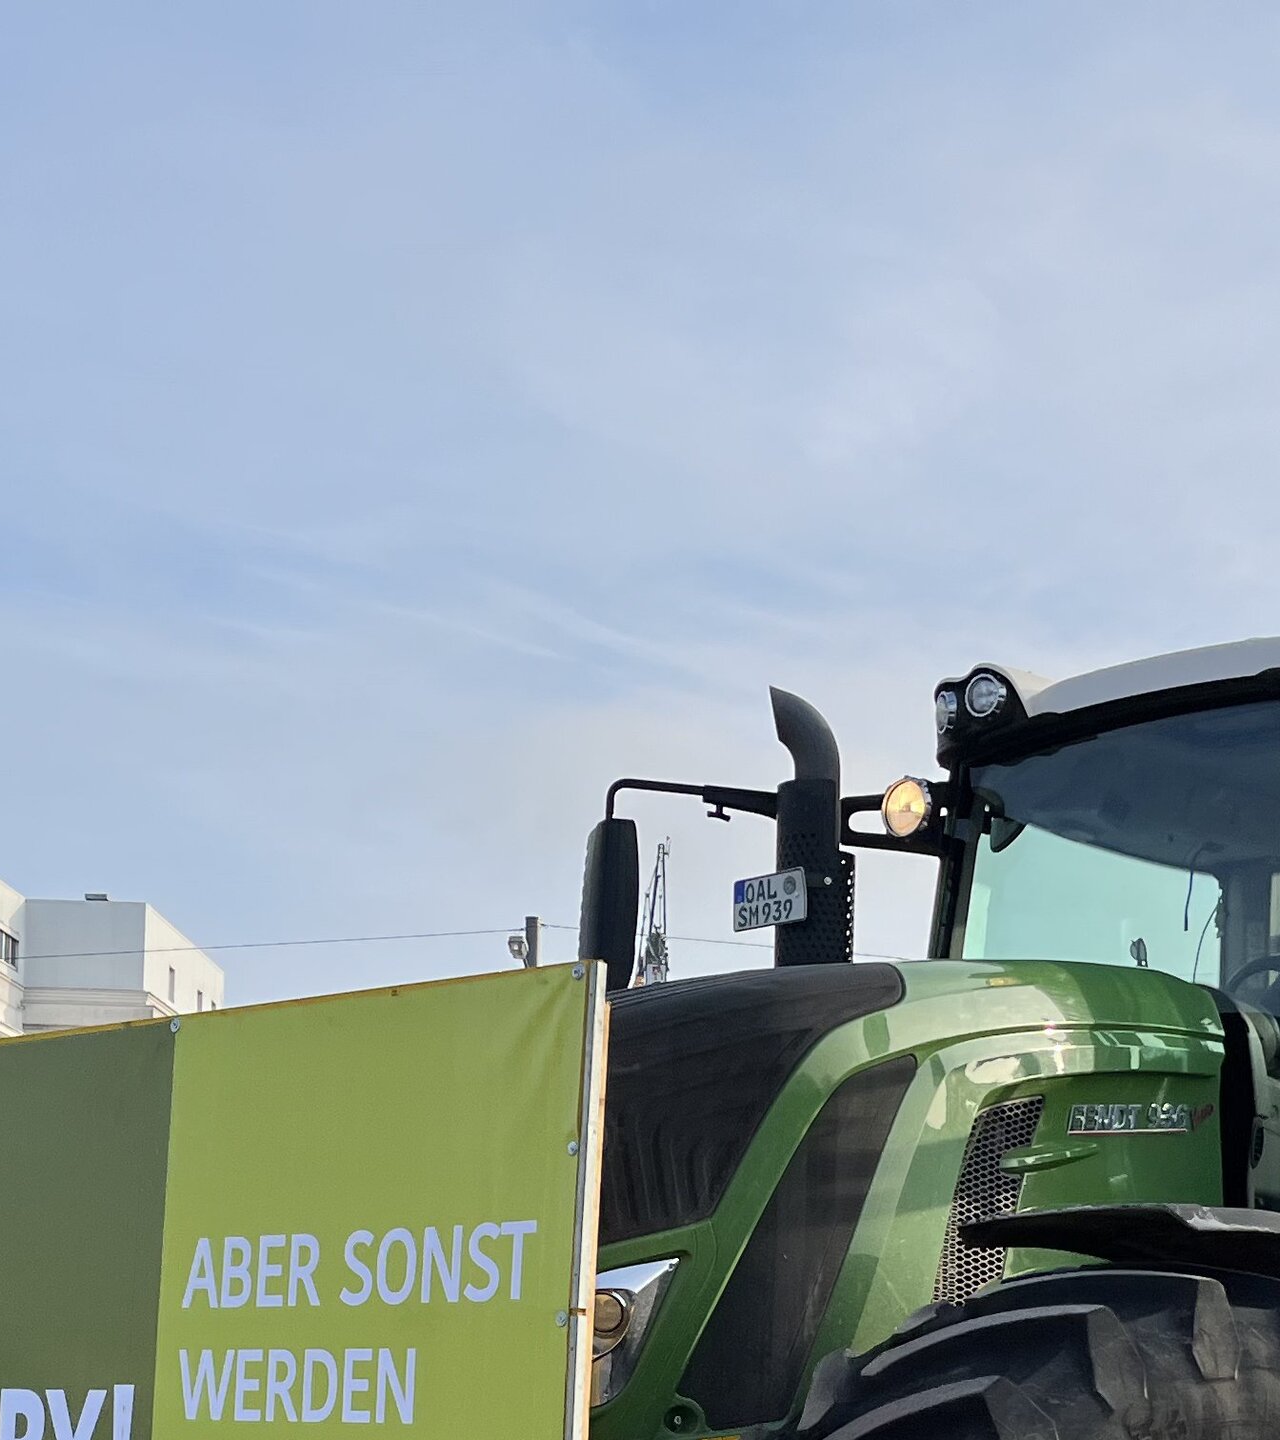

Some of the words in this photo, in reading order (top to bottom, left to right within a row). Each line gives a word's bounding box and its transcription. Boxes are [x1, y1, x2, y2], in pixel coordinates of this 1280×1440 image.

[745, 878, 777, 903] OAL
[1068, 1103, 1143, 1131] FENDT
[181, 1233, 321, 1309] ABER
[339, 1219, 538, 1307] SONST
[179, 1347, 417, 1425] WERDEN
